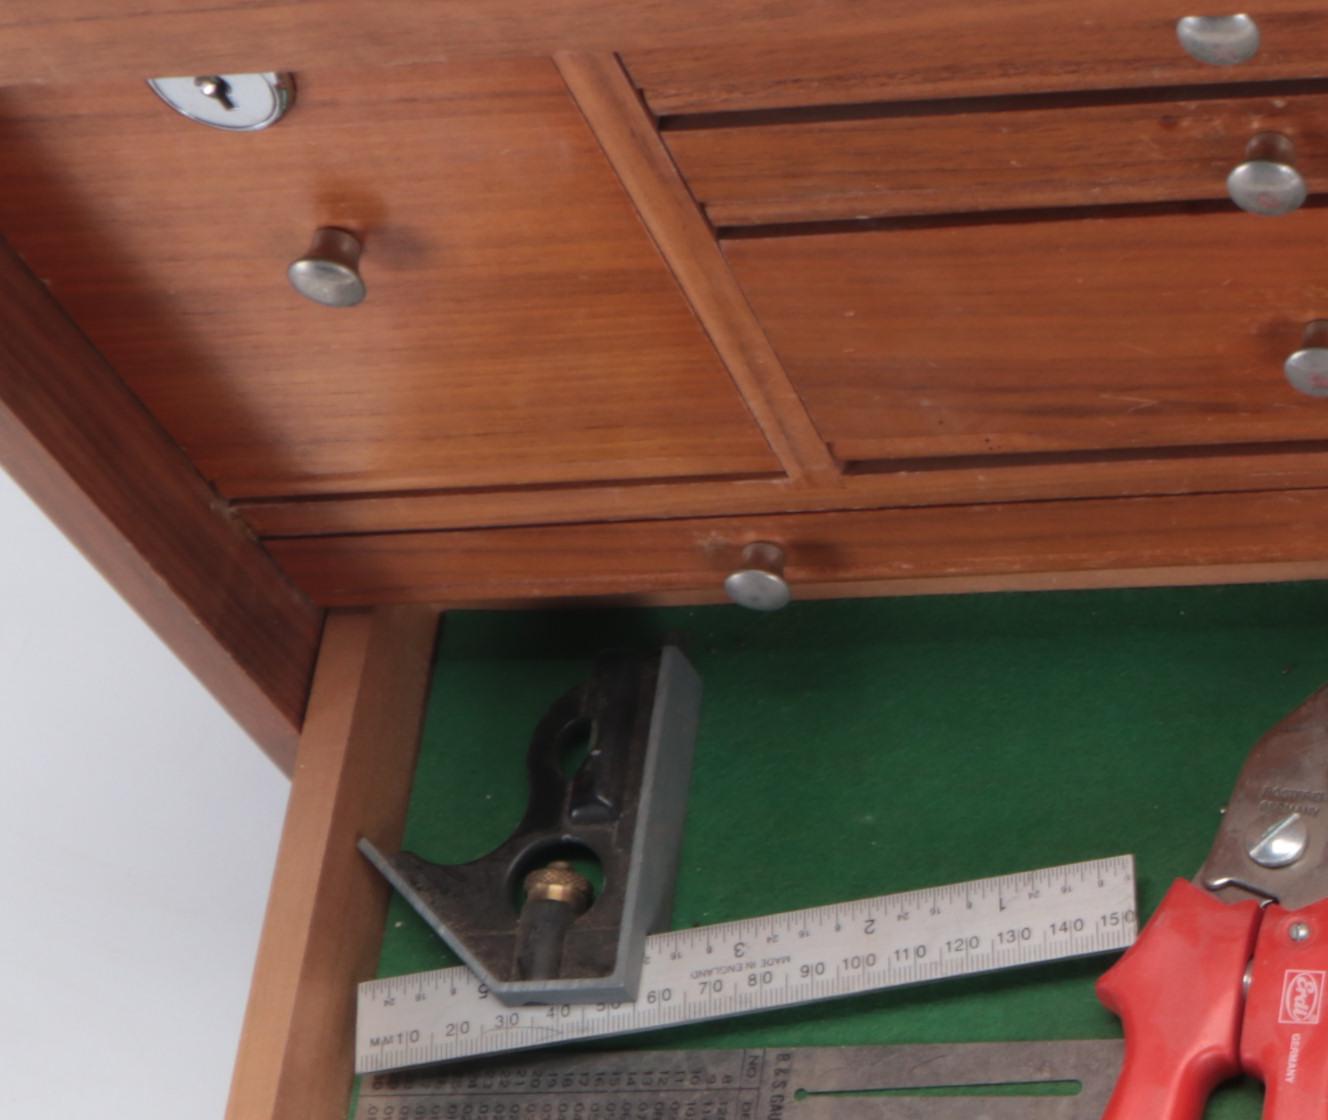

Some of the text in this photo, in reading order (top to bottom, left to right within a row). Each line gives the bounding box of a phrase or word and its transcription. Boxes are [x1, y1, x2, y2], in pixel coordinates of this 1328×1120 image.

[864, 920, 876, 934] 2
[734, 942, 745, 958] 3
[397, 1030, 420, 1045] 10
[445, 1021, 470, 1037] 20
[496, 1012, 520, 1028] 30
[546, 1004, 571, 1019] 40
[647, 988, 672, 1004] 60
[698, 979, 722, 995] 70
[748, 971, 772, 987] 80
[800, 963, 826, 978] 90
[842, 952, 877, 970] 100
[894, 944, 926, 961] 110
[946, 936, 980, 952] 120
[997, 927, 1032, 944] 130
[1049, 918, 1084, 934] 140
[1100, 909, 1136, 926] 150
[690, 955, 791, 979] MADE IN ENGLAND
